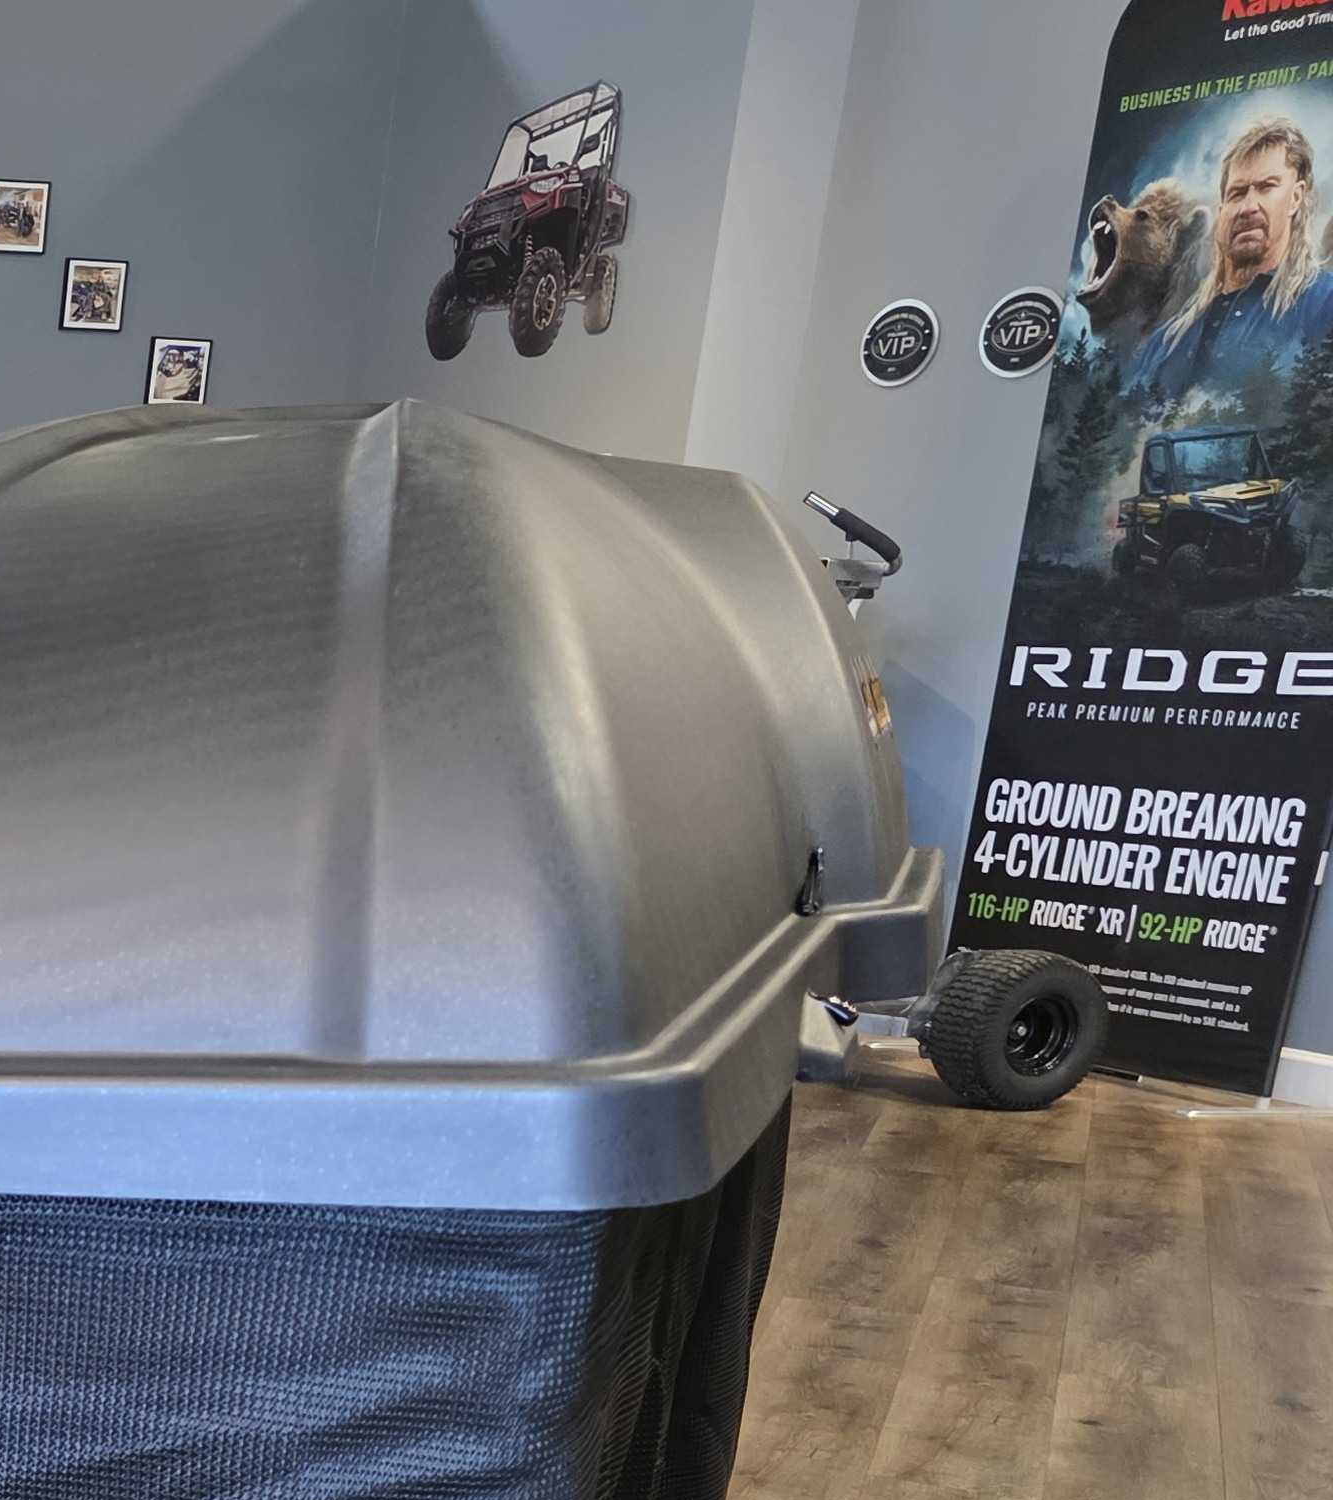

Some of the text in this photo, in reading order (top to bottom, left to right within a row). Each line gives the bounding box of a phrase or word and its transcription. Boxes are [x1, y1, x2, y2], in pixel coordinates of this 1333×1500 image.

[1224, 12, 1333, 42] Let the Good Tim
[1119, 85, 1192, 113] BUSINESS
[1194, 80, 1212, 99] IN
[1215, 75, 1245, 95] THE
[878, 336, 916, 356] VIP
[1000, 325, 1041, 347] VIP
[1009, 645, 1333, 697] RIDGE
[1026, 702, 1301, 730] PEAK PREMIUM PERFORMANCE
[984, 778, 1306, 847] GROUND BREAKING
[974, 831, 1296, 905] 4-CYLINDER ENGINE
[968, 892, 1029, 923] 116-HP
[1096, 907, 1124, 937] XR
[1138, 912, 1203, 945] 92-HP
